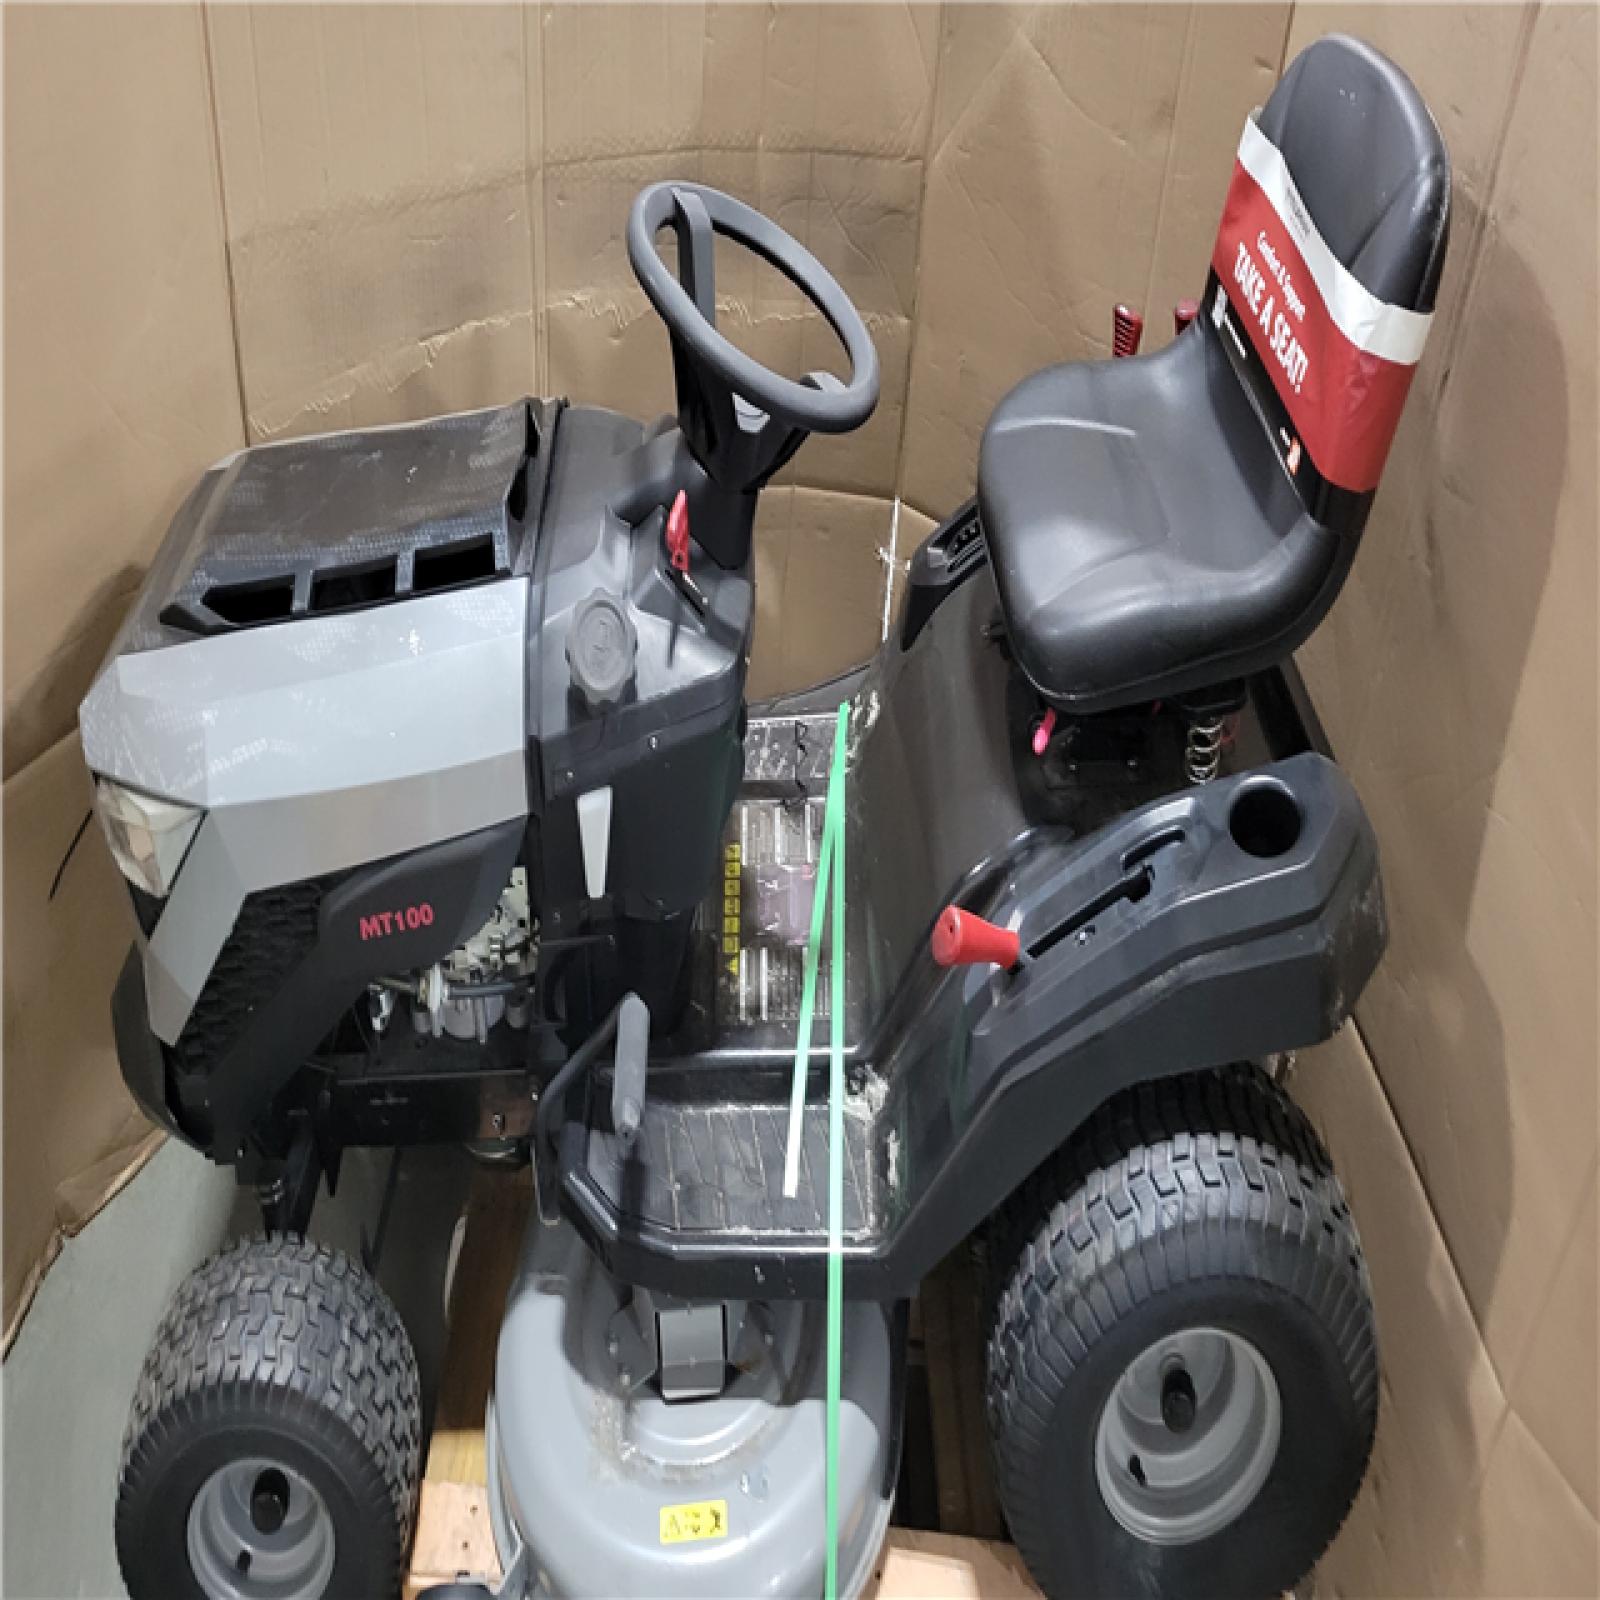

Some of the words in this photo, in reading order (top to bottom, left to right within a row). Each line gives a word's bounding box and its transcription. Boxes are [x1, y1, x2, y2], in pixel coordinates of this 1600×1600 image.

[1234, 241, 1265, 315] TAKE
[1259, 295, 1275, 335] A
[1270, 311, 1309, 393] SEAT!
[359, 902, 434, 940] MT100
